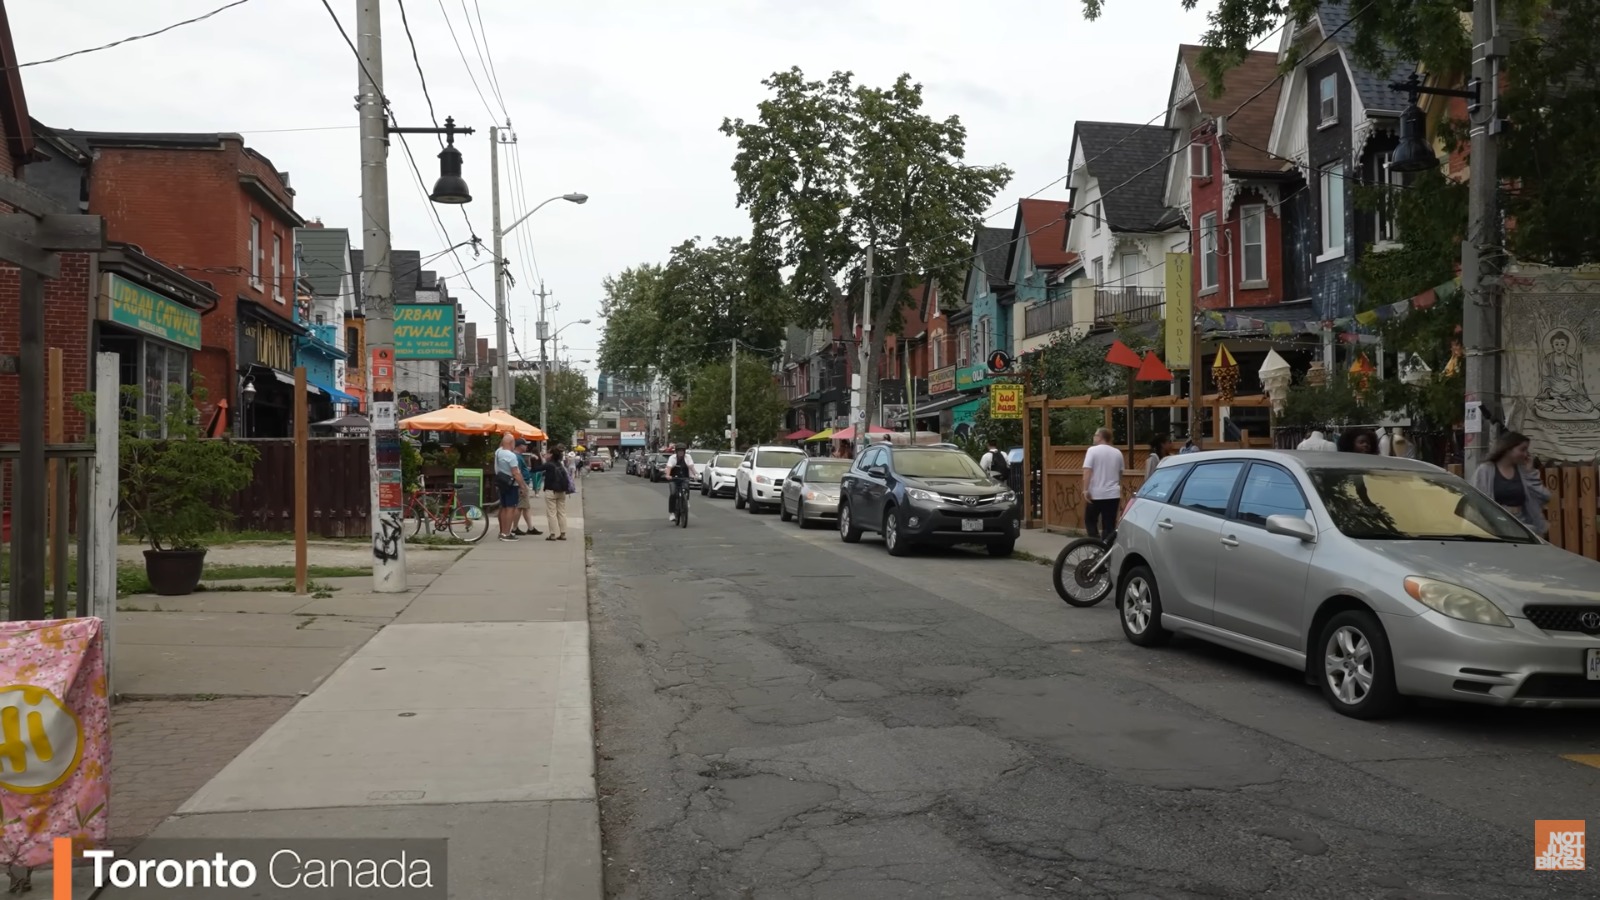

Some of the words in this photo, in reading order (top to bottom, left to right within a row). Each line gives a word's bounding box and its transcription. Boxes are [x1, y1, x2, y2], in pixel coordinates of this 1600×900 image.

[113, 281, 153, 321] URBAN
[156, 300, 200, 337] CATWALK
[1175, 265, 1184, 323] DANCING
[393, 308, 442, 321] URBAN
[394, 325, 452, 338] ATWALK
[1175, 328, 1184, 361] DAYS
